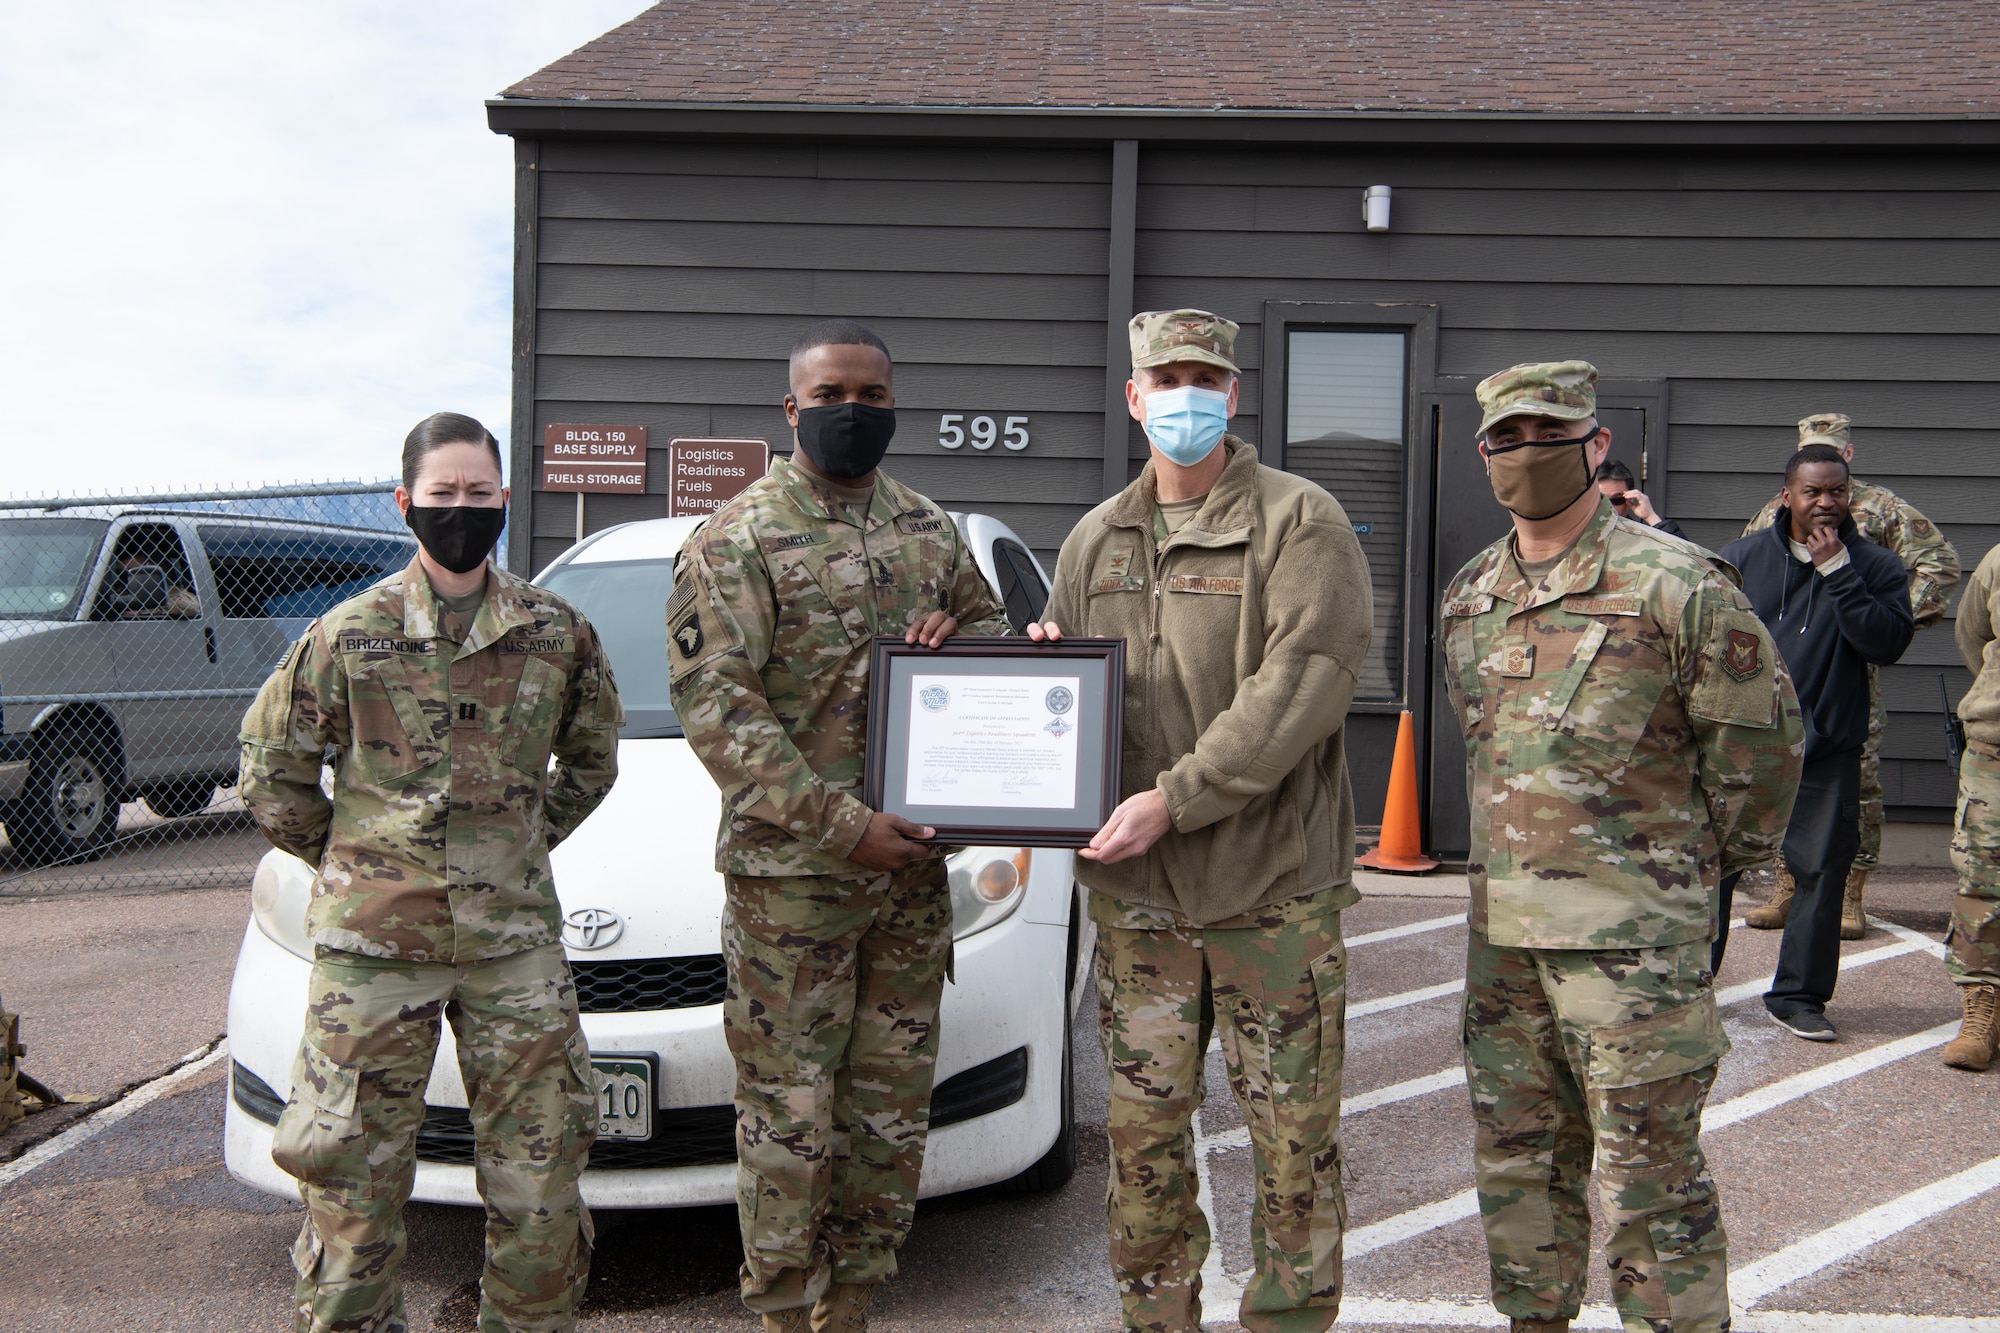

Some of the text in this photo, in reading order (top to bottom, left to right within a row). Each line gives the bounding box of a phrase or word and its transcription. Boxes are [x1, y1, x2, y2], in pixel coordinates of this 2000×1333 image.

[566, 431, 626, 442] BLDG. 150
[939, 414, 1029, 451] 595
[554, 444, 636, 455] BASE SUPPLY
[677, 447, 734, 462] Logistics
[677, 463, 746, 477] Readiness
[547, 474, 642, 485] FUELS STORAGE
[677, 480, 712, 492] Fuels
[777, 534, 814, 548] SMITH
[1189, 577, 1207, 591] AIR
[1209, 578, 1240, 592] FORCE
[1585, 600, 1604, 612] AIR
[1605, 600, 1638, 612] FORCE
[346, 639, 430, 653] BRIZENDINE
[920, 689, 949, 698] Nickel
[601, 1082, 640, 1119] 10
